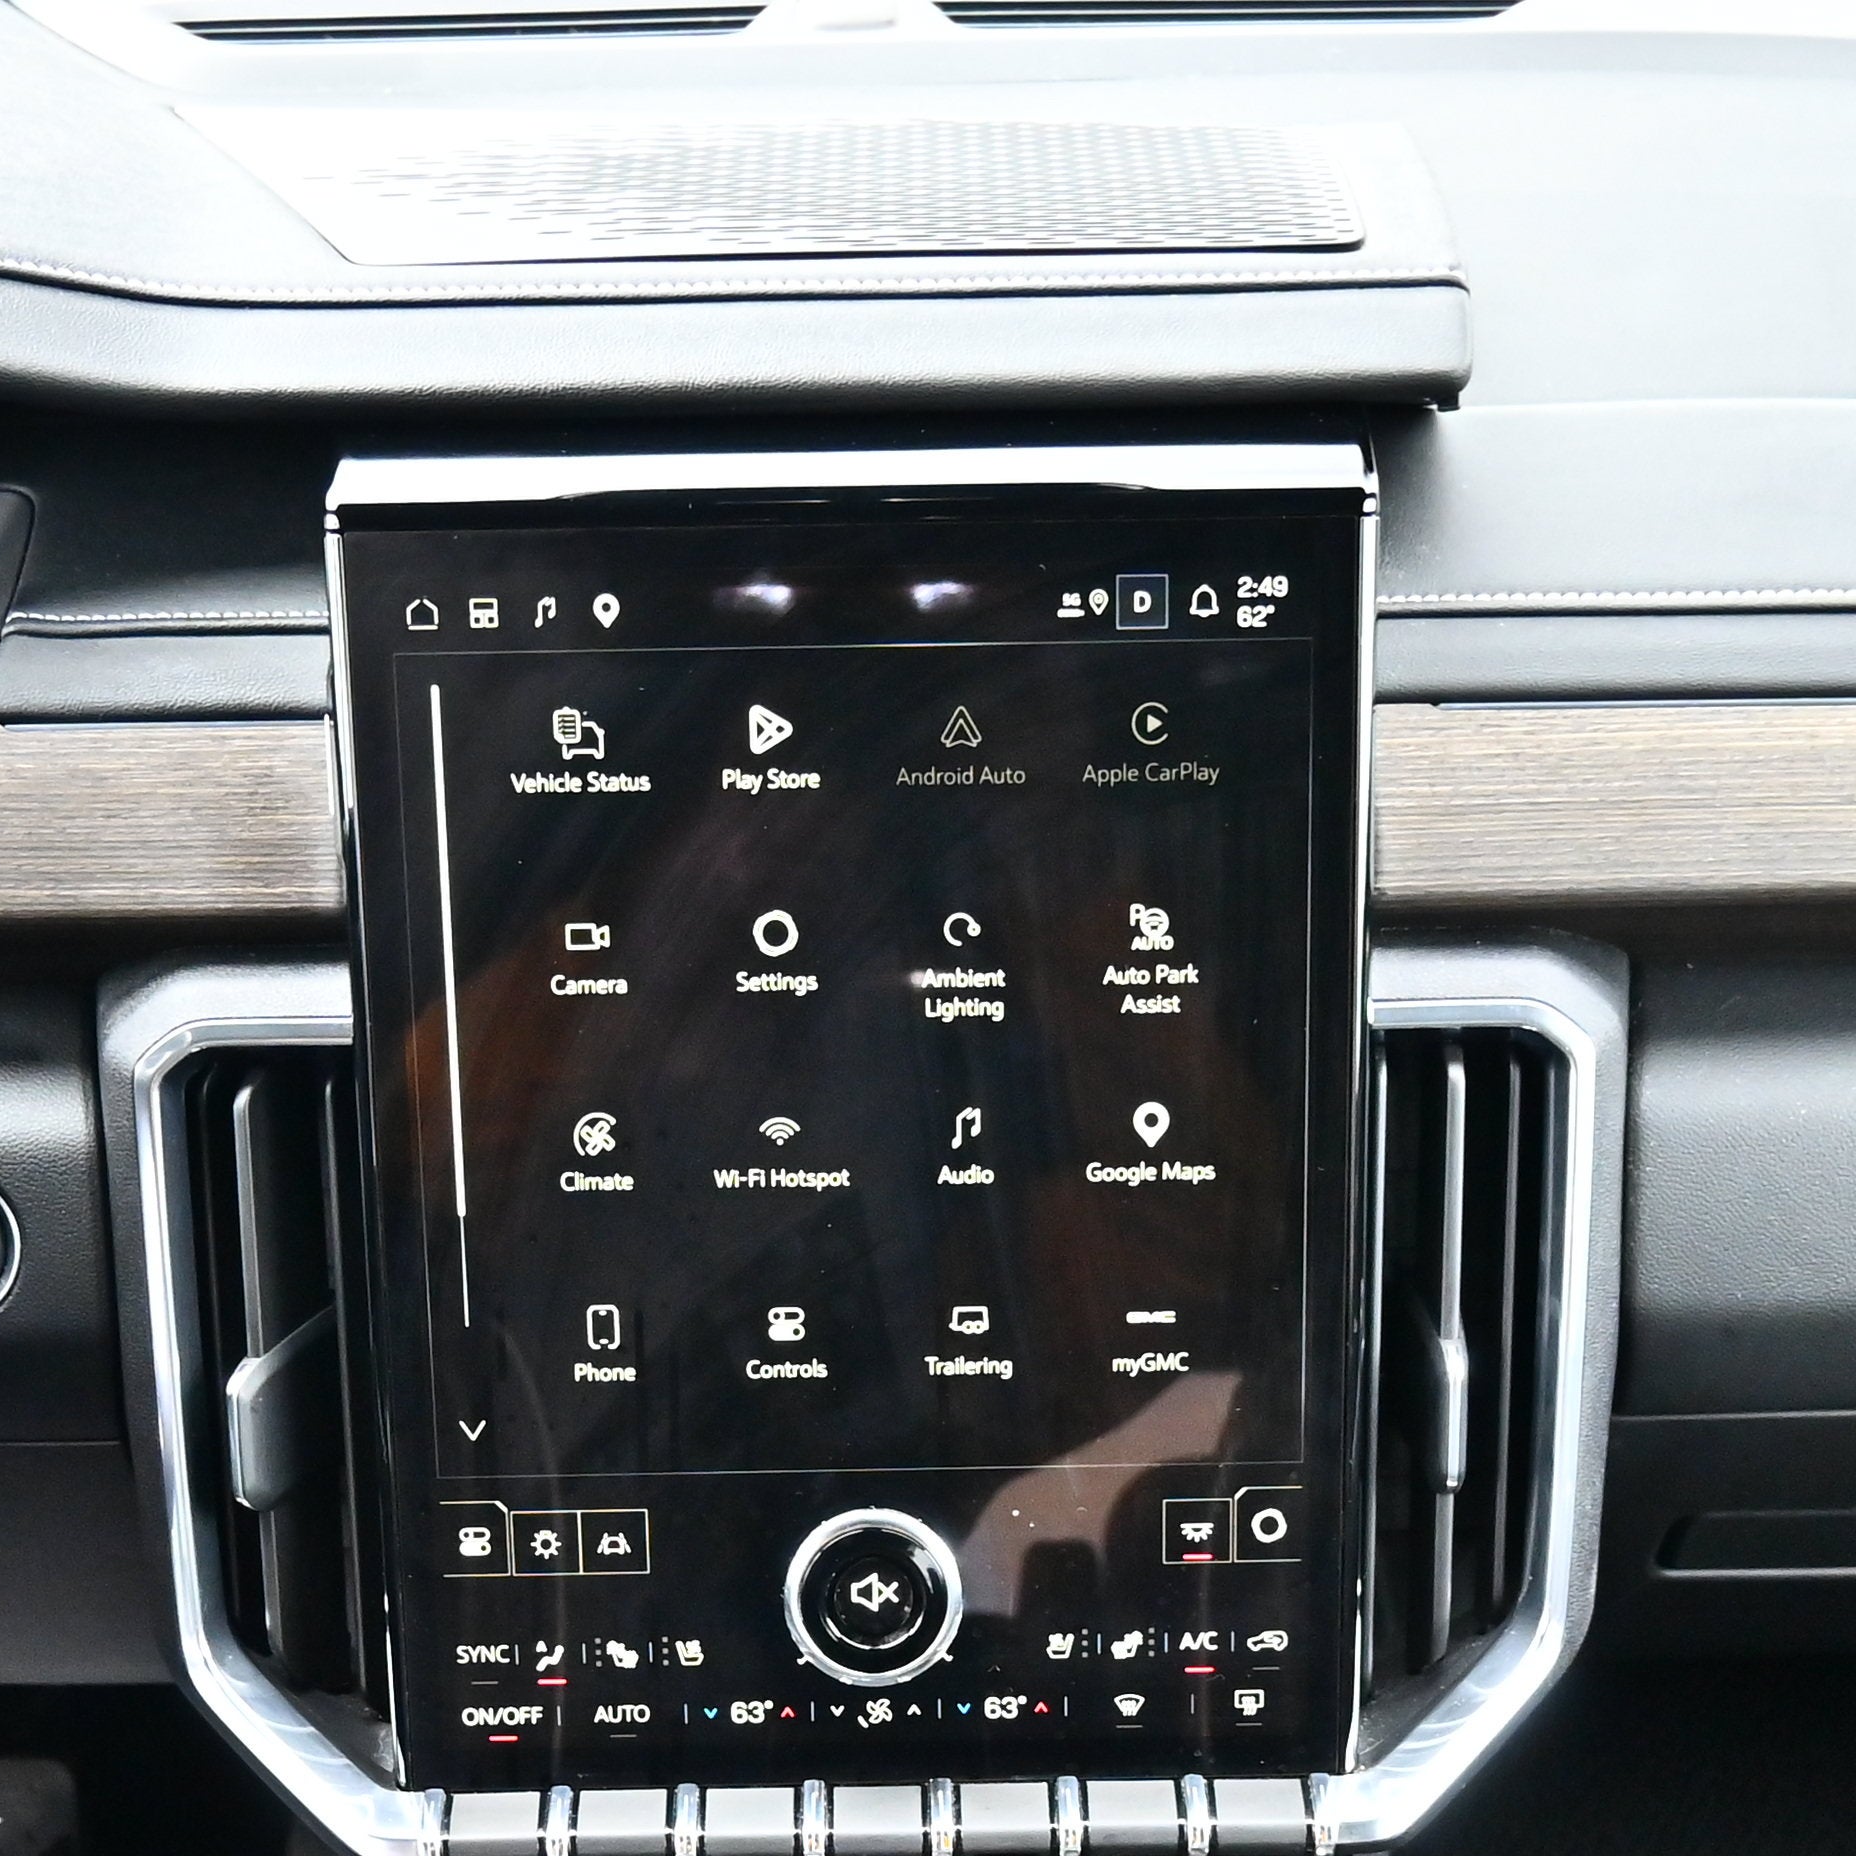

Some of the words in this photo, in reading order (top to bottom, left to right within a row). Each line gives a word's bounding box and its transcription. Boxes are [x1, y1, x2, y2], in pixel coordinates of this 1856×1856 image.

[1237, 575, 1289, 599] 2:49
[1237, 604, 1276, 628] 62°
[511, 771, 581, 794] Vehicle
[586, 770, 651, 793] Status
[722, 769, 764, 795] Play
[768, 768, 821, 790] Store
[896, 765, 973, 786] Android
[979, 765, 1026, 785] Auto
[1082, 763, 1139, 787] Apple
[1145, 761, 1220, 787] CarPlay
[551, 975, 628, 996] Camera
[736, 971, 819, 997] Settings
[922, 966, 1006, 989] Ambient
[1102, 965, 1151, 986] Auto
[1155, 962, 1200, 985] Park
[924, 996, 1005, 1023] Lighting
[1120, 993, 1182, 1015] Assist
[559, 1170, 635, 1192] Climate
[713, 1168, 766, 1189] Wi-Fi
[771, 1167, 851, 1192] Hotspot
[937, 1163, 995, 1185] Audio
[1085, 1161, 1157, 1187] Google
[1161, 1161, 1217, 1187] Maps
[574, 1362, 637, 1383] Phone
[746, 1357, 828, 1381] Controls
[924, 1355, 1013, 1381] Trailering
[1112, 1351, 1190, 1378] myGMC
[1179, 1630, 1220, 1651] A/C
[456, 1644, 511, 1665] SYNC
[461, 1706, 544, 1727] ON/OFF
[593, 1704, 651, 1724] AUTO
[730, 1700, 774, 1725] 63°
[984, 1695, 1028, 1720] 63°
